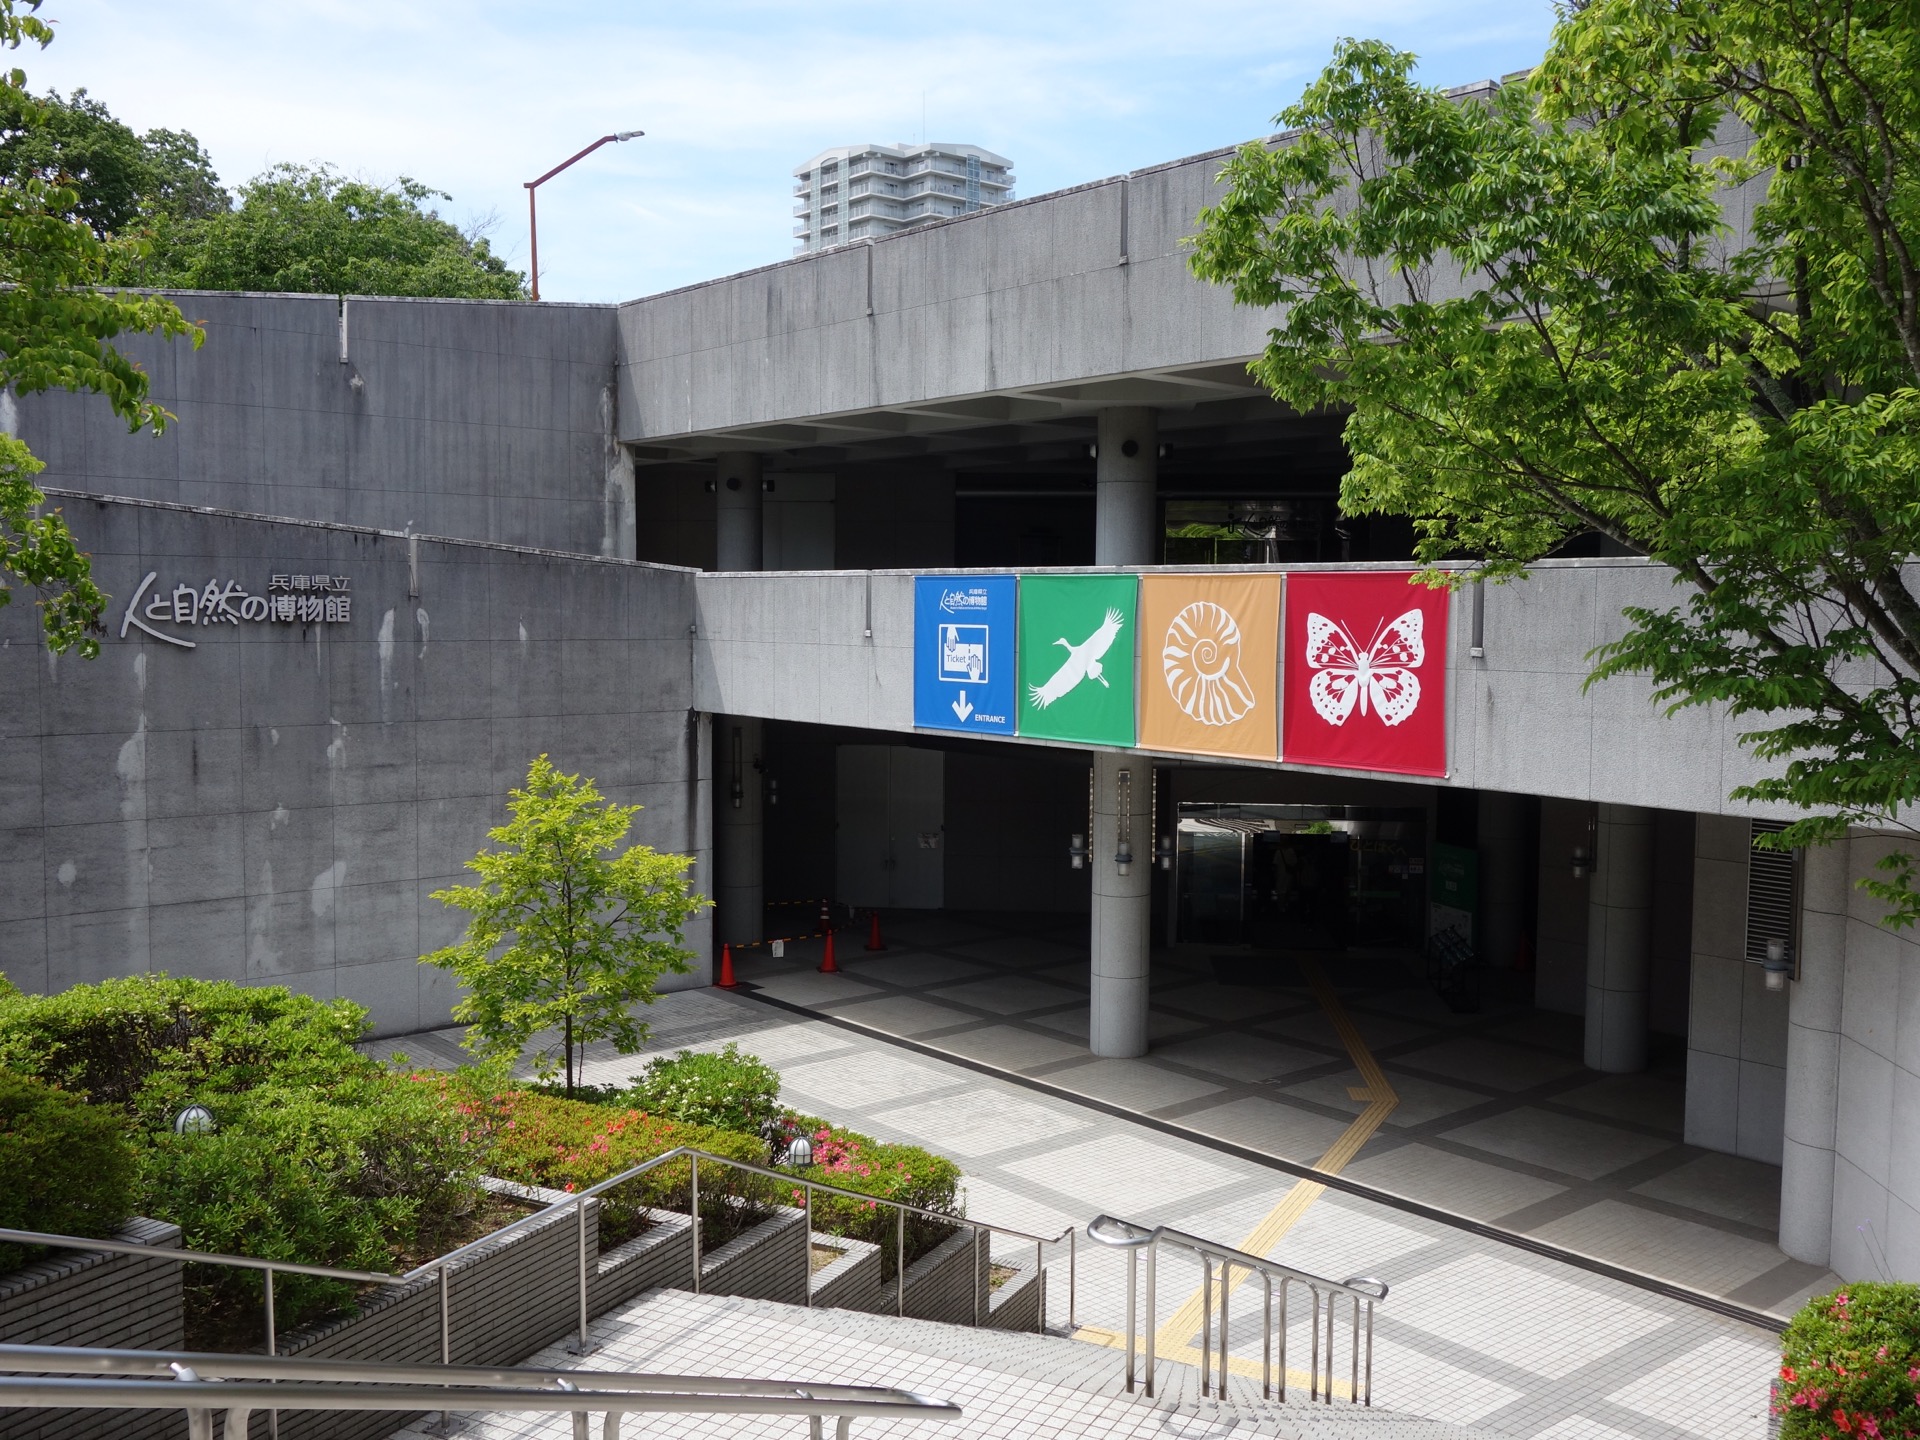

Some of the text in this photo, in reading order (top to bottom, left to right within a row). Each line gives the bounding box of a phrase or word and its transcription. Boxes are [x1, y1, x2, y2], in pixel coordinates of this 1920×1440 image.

[268, 574, 351, 592] 兵庫県立
[120, 571, 351, 647] 人と自然の博物館
[946, 654, 967, 663] Ticket
[974, 713, 1006, 724] ENTRANCE
